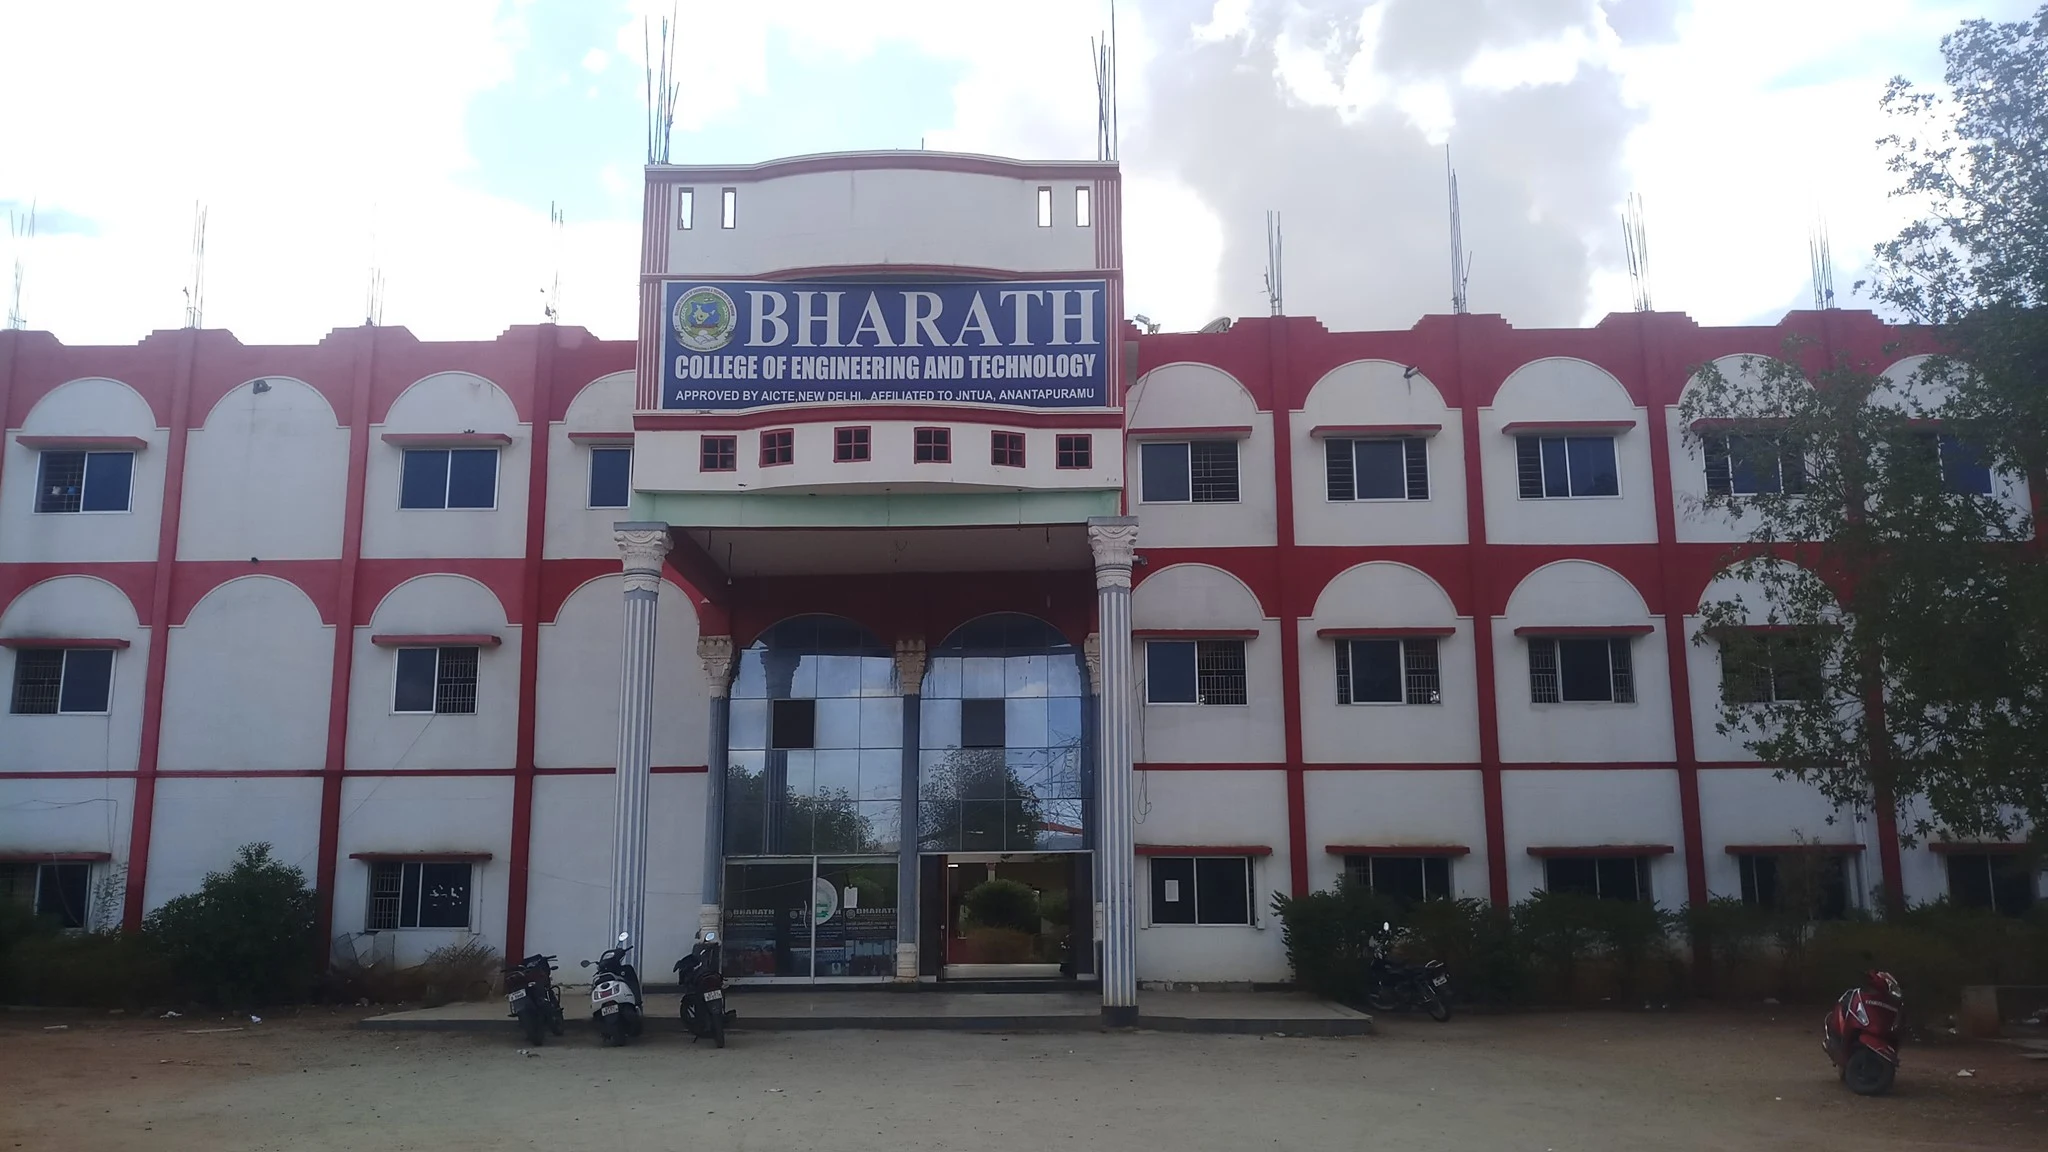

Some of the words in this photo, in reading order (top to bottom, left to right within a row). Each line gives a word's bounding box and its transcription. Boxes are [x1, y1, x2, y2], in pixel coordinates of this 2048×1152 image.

[744, 290, 1100, 347] BHARATH
[675, 355, 758, 380] COLLEGE
[763, 355, 787, 380] OF
[791, 356, 919, 380] ENGINEERING
[924, 356, 965, 380] AND
[969, 353, 1096, 379] TECHNOLOGY
[675, 390, 740, 401] APPROVED
[742, 390, 759, 401] BY
[870, 391, 934, 401] AFFILIATED
[937, 390, 953, 401] TO
[956, 390, 996, 401] JNTUA,
[999, 388, 1095, 400] ANANTAPURAMU
